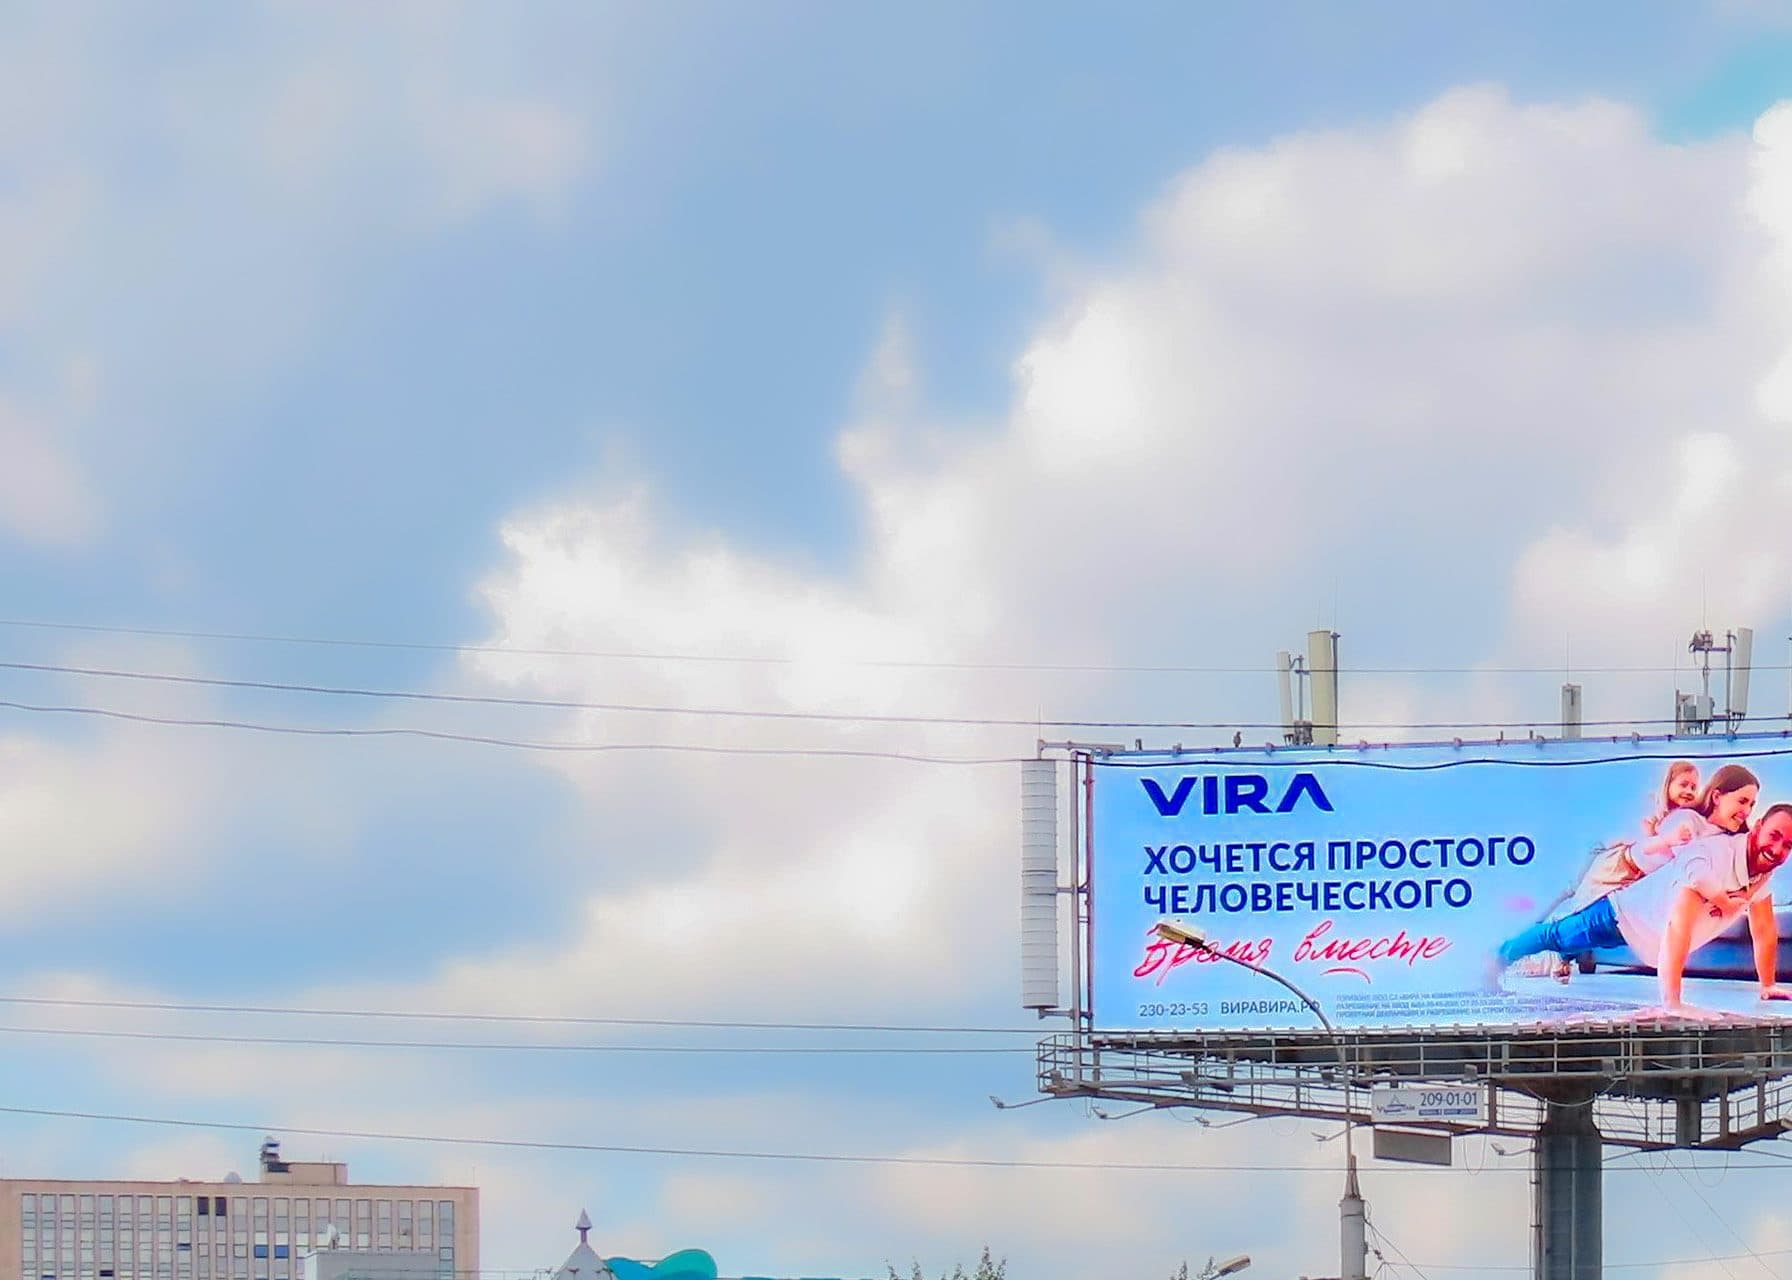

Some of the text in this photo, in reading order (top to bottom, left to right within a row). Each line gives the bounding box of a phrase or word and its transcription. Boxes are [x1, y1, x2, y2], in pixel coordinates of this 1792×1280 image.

[1140, 773, 1334, 817] VIRA
[1143, 835, 1536, 876] ХОЧЕТСЯ ПРОСТОГО
[1143, 878, 1473, 914] ЧЕЛОВЕЧЕСКОГО
[1294, 920, 1453, 966] вместе
[1139, 1000, 1320, 1017] 230-23-53 ВИРАВИРА.РФ
